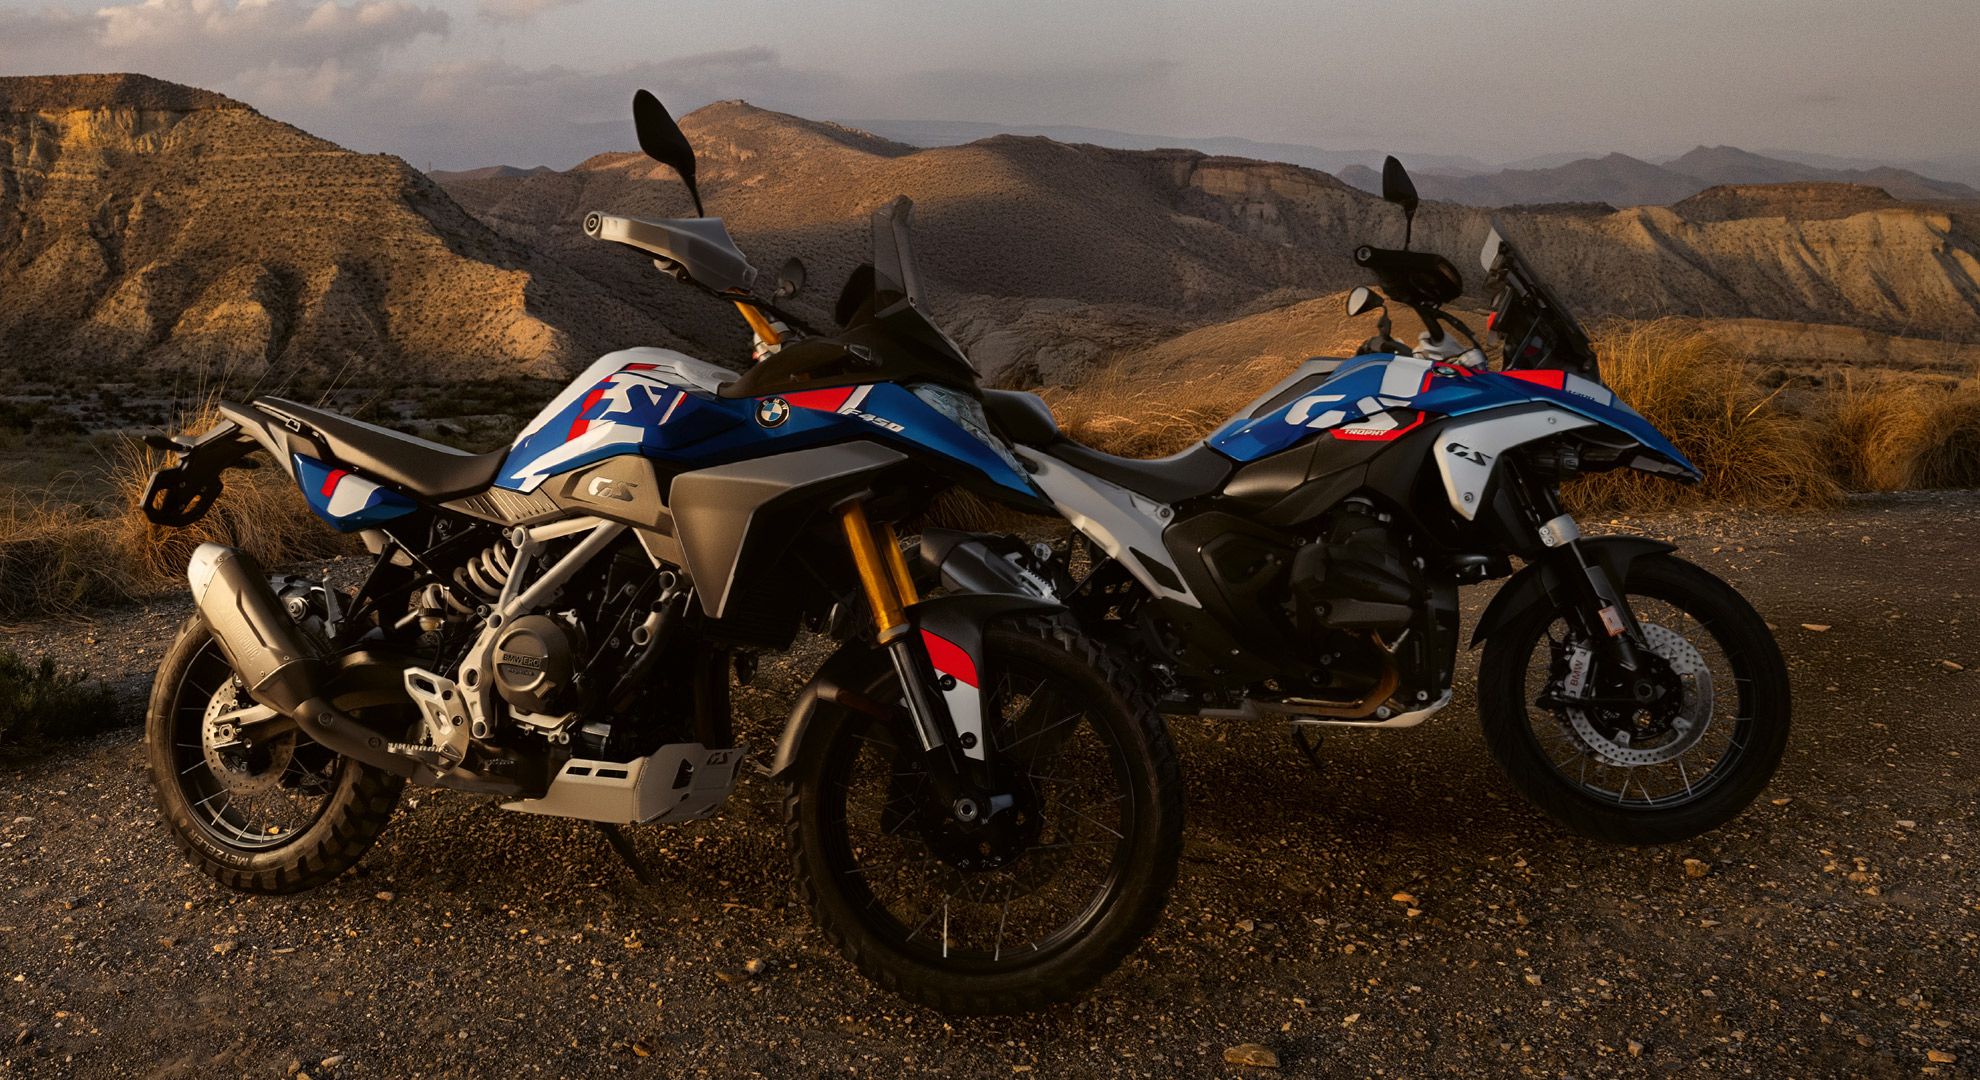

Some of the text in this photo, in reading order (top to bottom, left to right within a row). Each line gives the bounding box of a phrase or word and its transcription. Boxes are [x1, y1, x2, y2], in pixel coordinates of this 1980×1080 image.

[1284, 393, 1412, 430] GS
[1344, 429, 1387, 437] TROPHY
[1446, 442, 1493, 467] GS
[588, 476, 639, 502] GS
[503, 653, 523, 666] BMW
[1570, 659, 1584, 687] BMW
[187, 828, 249, 866] METZELER
